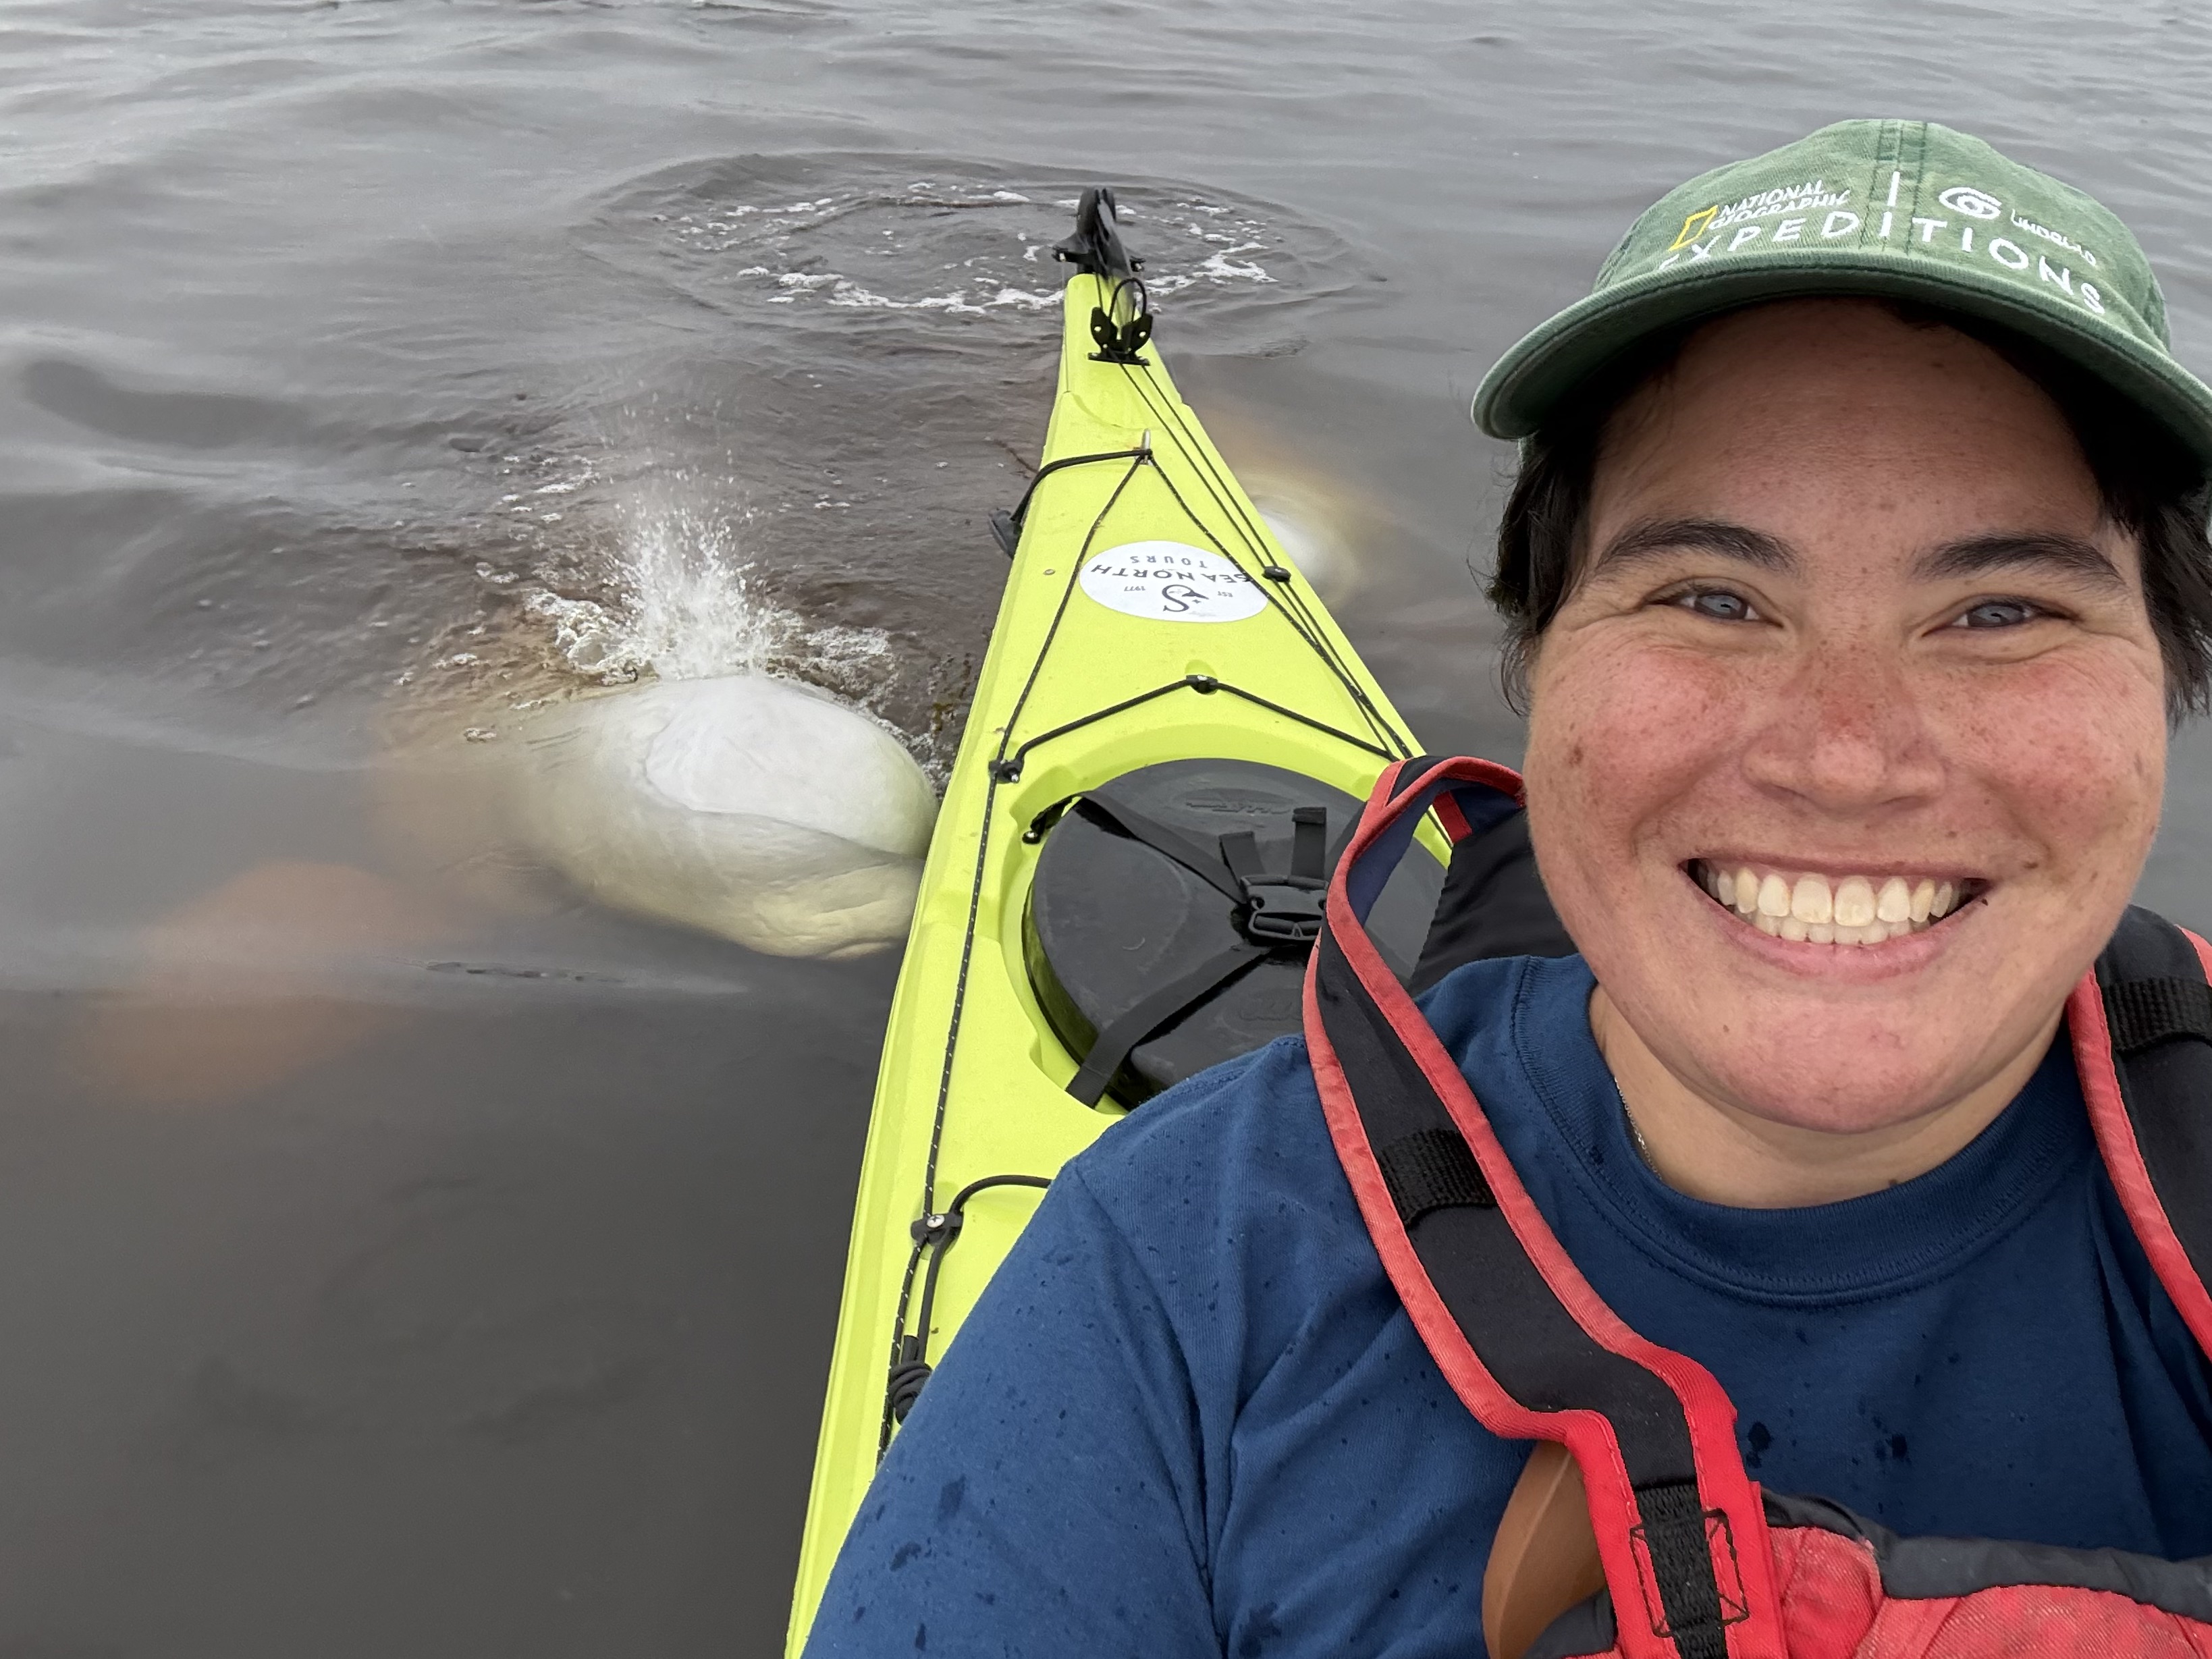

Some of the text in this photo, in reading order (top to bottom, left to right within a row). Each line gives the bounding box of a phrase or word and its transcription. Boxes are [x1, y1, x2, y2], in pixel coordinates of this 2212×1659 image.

[1708, 190, 1851, 230] GEOGRAPHIC
[1718, 180, 1825, 219] NATIONAL
[1090, 564, 1250, 583] SEA NORTH
[1130, 555, 1208, 569] TOURS
